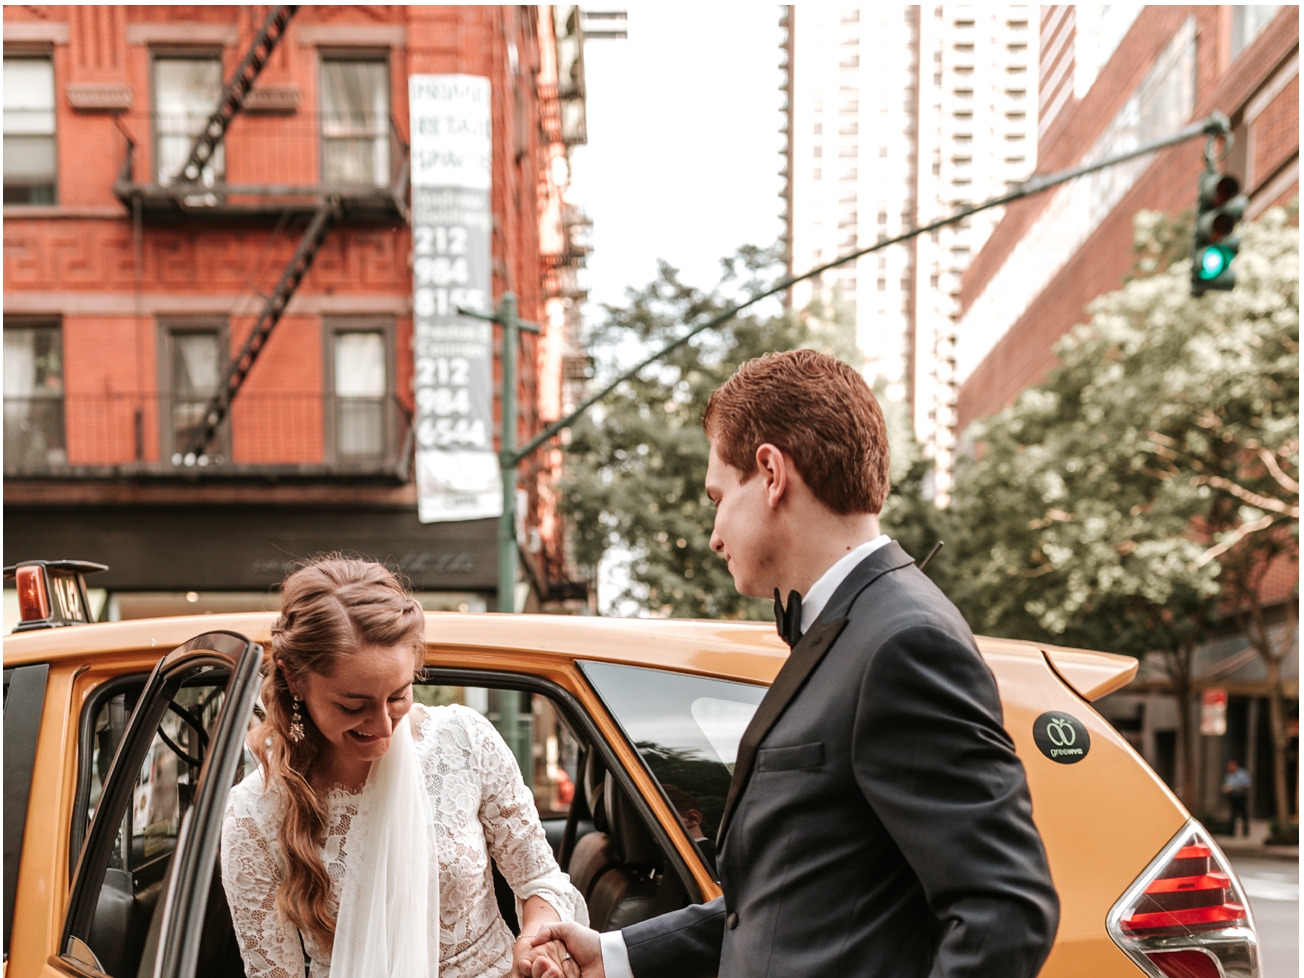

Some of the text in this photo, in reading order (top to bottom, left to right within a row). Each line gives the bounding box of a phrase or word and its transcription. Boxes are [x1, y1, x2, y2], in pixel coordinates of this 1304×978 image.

[414, 226, 468, 255] 212
[414, 256, 470, 285] 984
[415, 357, 470, 386] 212
[415, 387, 471, 416] 984
[416, 417, 487, 447] 6544
